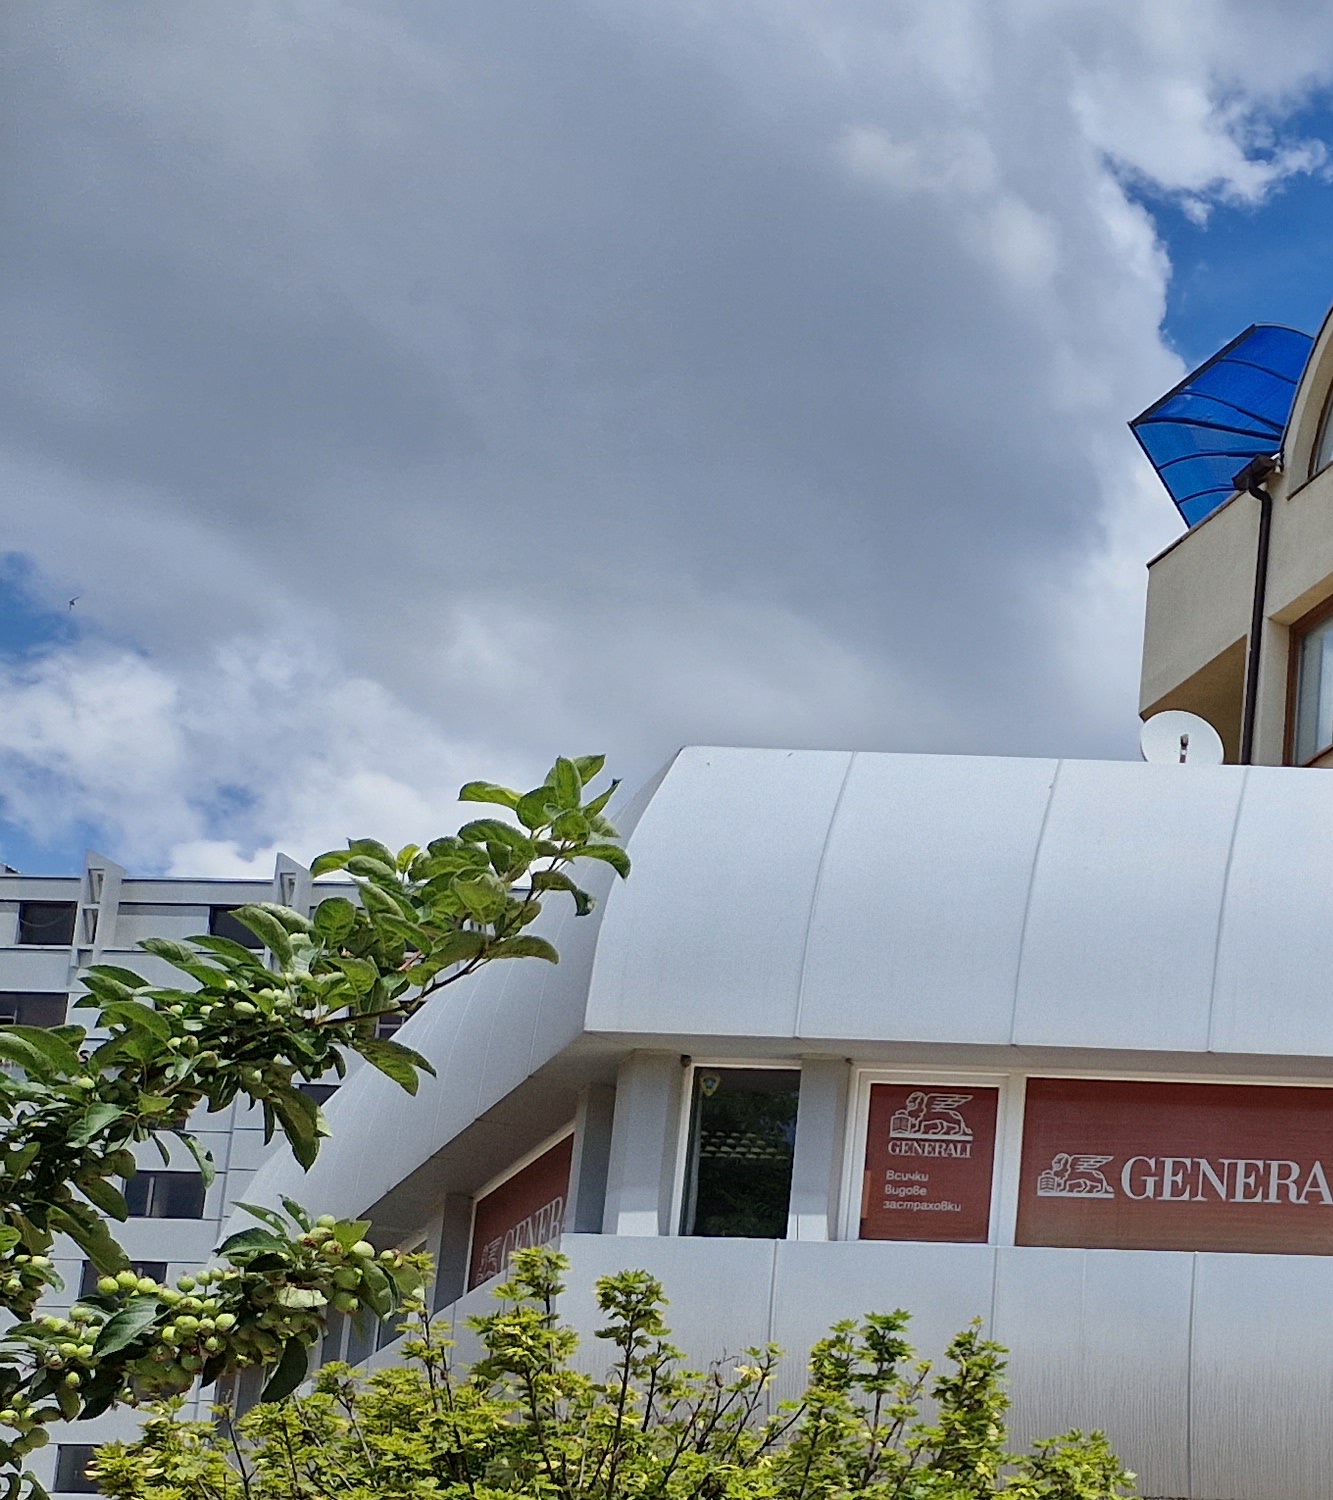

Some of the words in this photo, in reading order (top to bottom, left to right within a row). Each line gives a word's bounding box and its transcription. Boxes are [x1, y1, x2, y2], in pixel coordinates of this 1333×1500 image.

[887, 1140, 973, 1159] GENERALI
[885, 1169, 929, 1184] Всички
[883, 1184, 928, 1199] видове
[882, 1198, 962, 1214] застраховки
[500, 1196, 565, 1271] GENER
